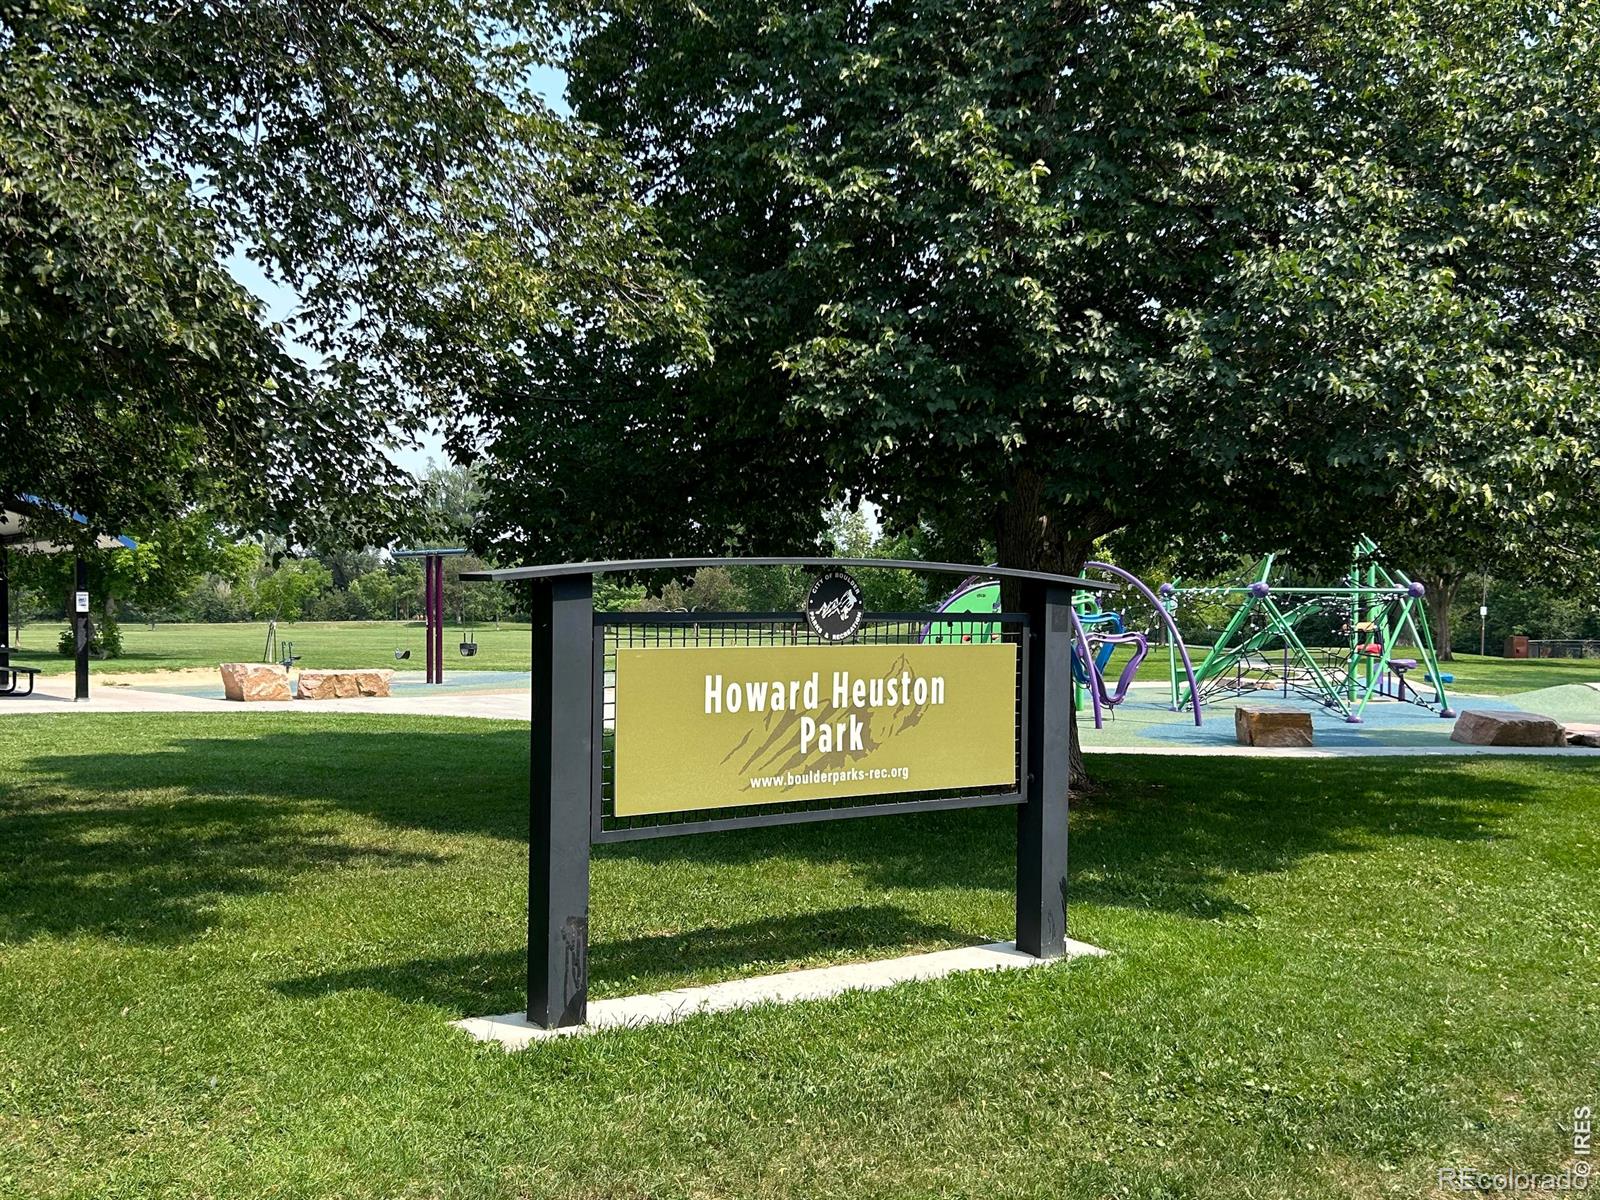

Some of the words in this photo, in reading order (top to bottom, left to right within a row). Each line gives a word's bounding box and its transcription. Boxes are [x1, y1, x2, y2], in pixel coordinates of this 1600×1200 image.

[812, 579, 823, 594] CITY
[834, 572, 860, 594] BOULDER
[704, 672, 819, 714] Howard
[832, 671, 945, 709] Heuston
[800, 714, 864, 754] Park
[750, 766, 909, 789] www.boulderparks-rec.org
